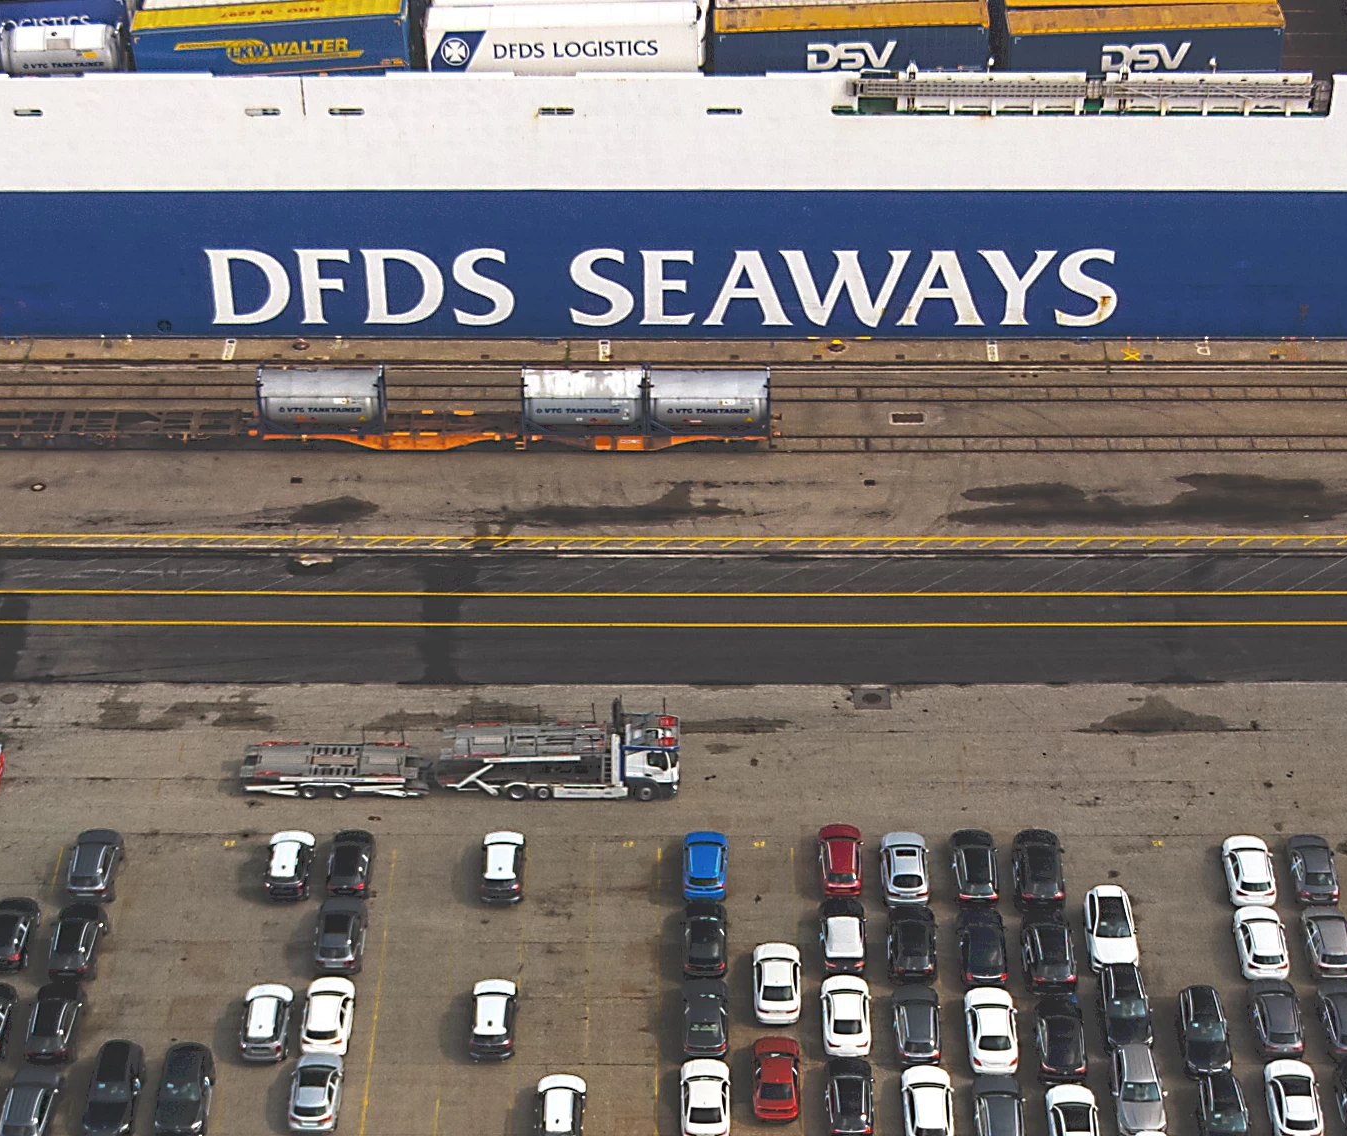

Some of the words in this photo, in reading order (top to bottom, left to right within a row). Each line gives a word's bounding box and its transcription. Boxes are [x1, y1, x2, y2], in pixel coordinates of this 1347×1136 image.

[230, 46, 266, 58] LKW
[271, 38, 348, 56] WALTER
[492, 42, 545, 60] DFDS
[553, 40, 659, 58] LOGISTICS
[806, 40, 898, 71] DSV
[1101, 42, 1192, 71] DSV
[204, 248, 515, 325] DFDS
[568, 248, 1118, 327] SEAWAYS
